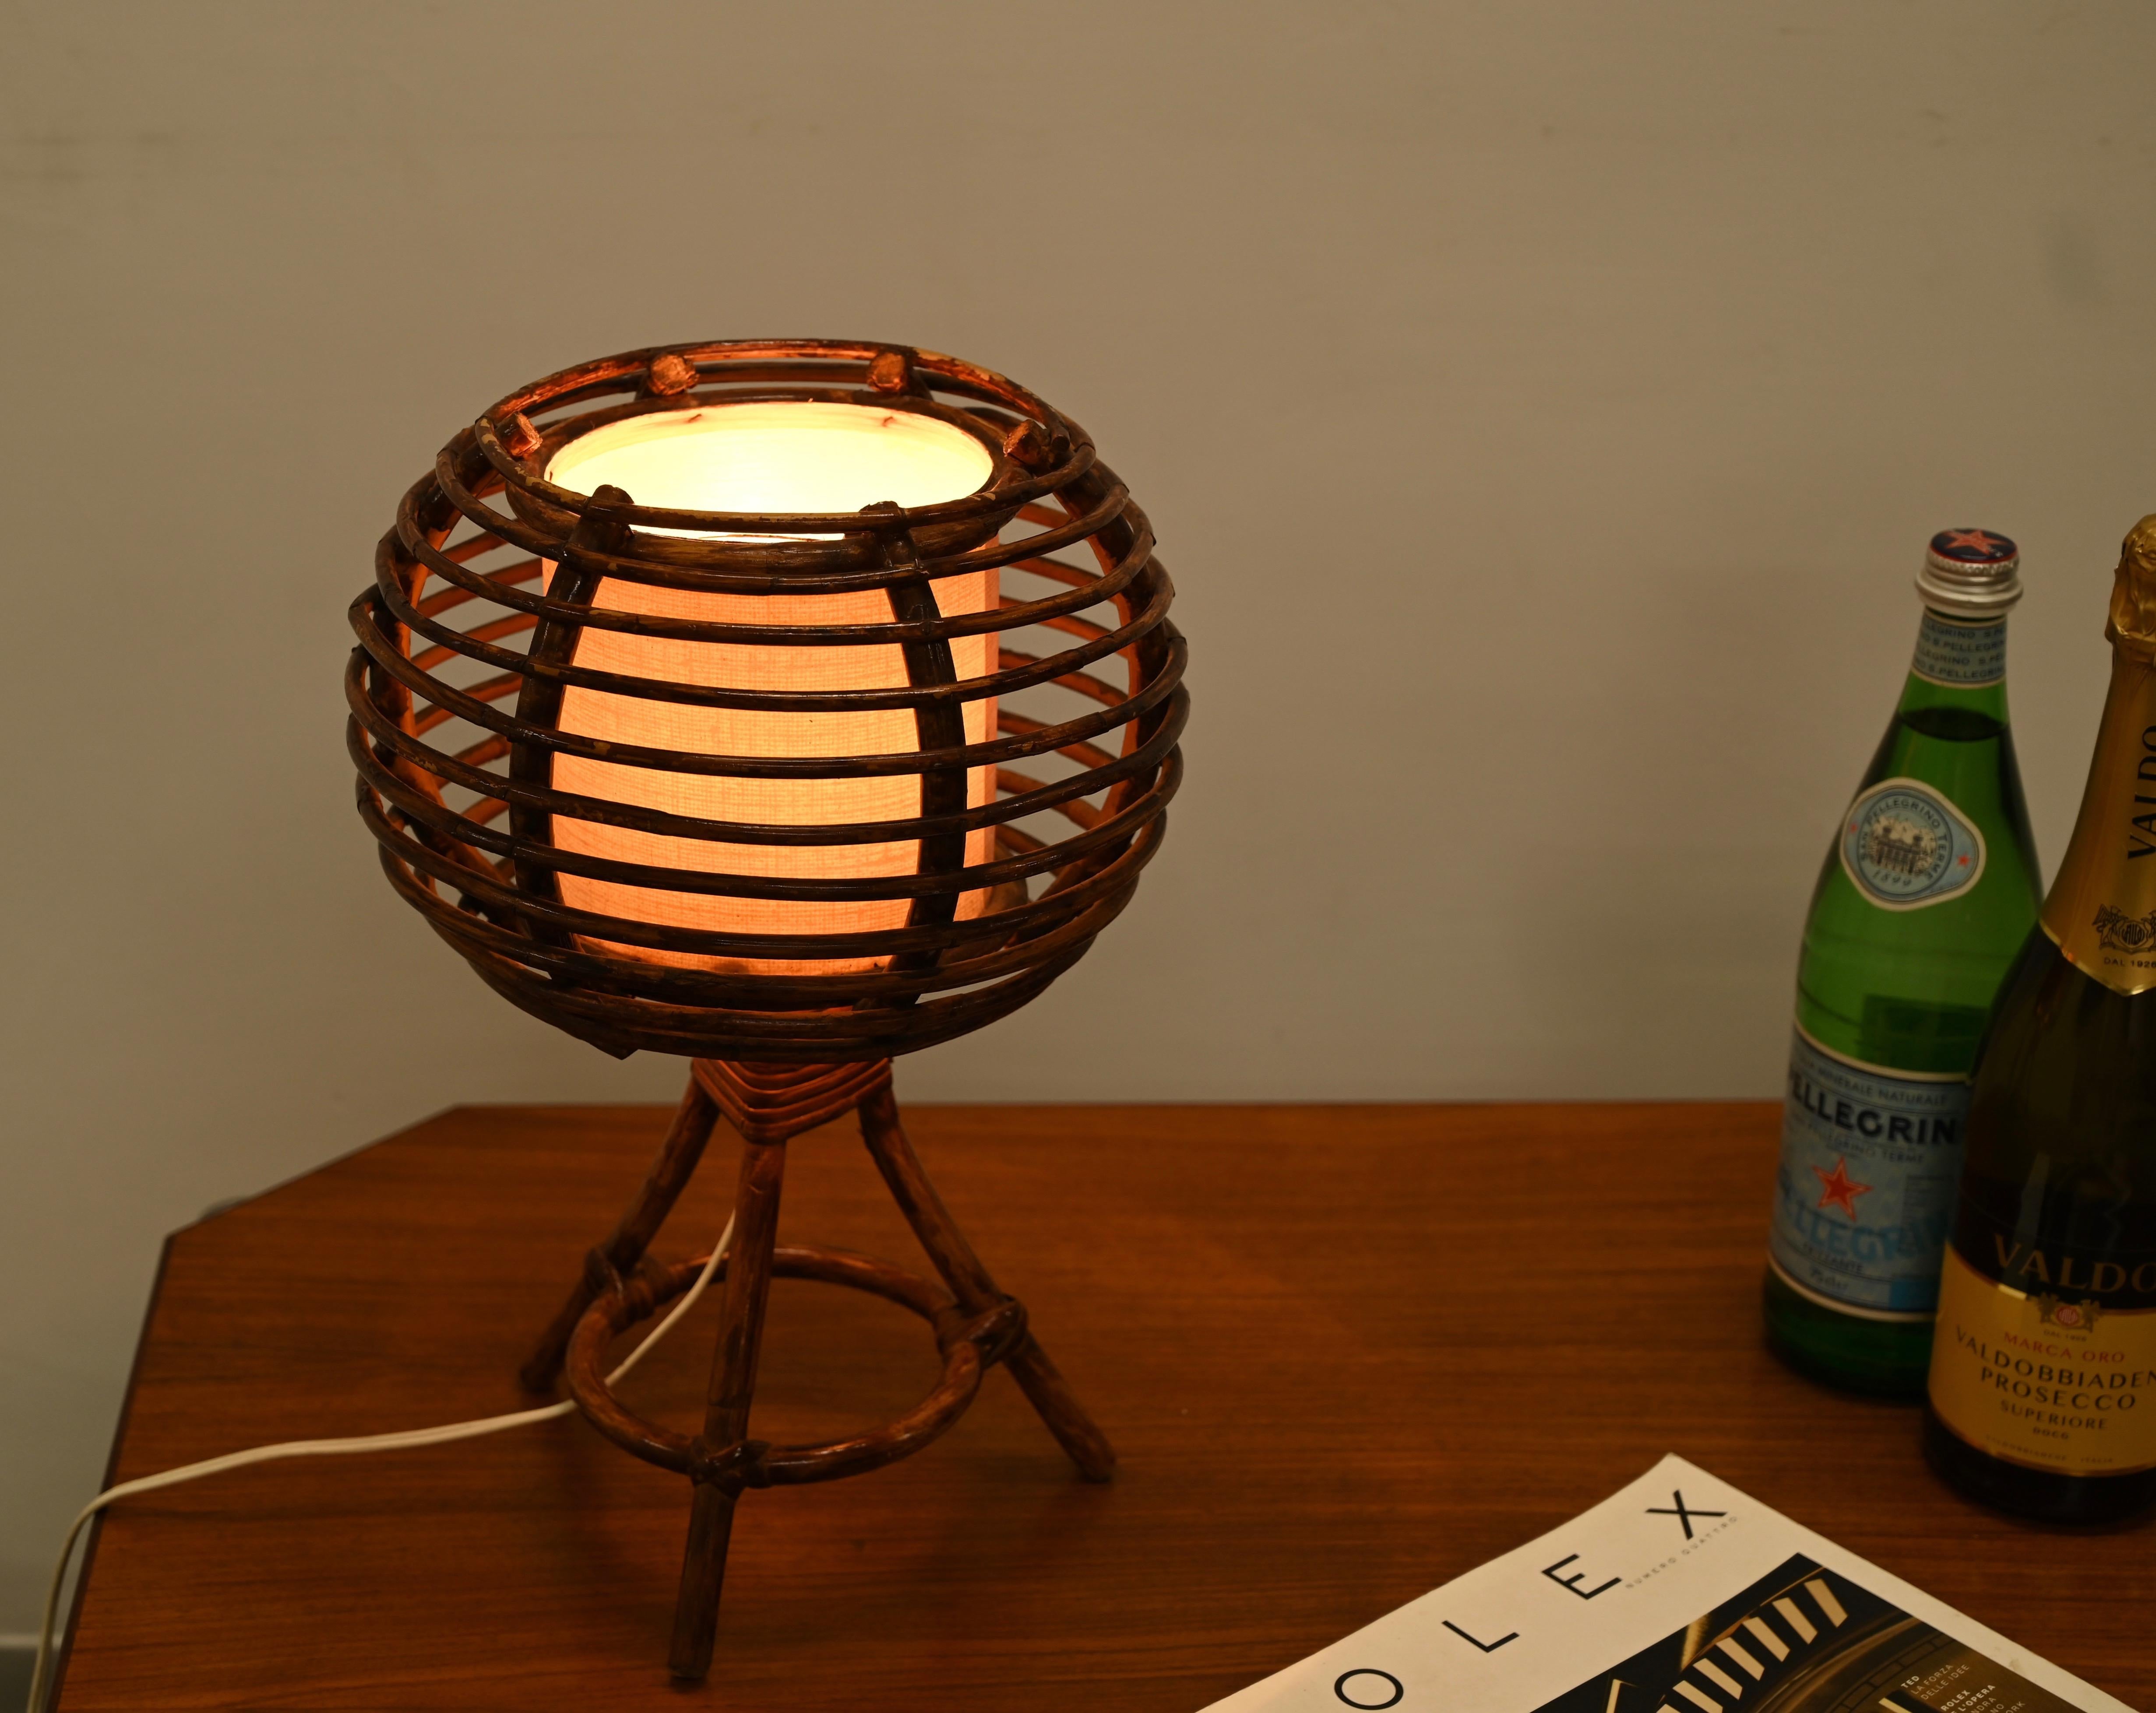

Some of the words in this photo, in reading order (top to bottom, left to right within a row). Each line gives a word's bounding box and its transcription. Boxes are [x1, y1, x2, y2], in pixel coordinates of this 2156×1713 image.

[1866, 797, 1941, 830] PELLEGRINO
[2103, 956, 2125, 966] DAL
[1994, 1233, 2156, 1293] VALDO
[2004, 1332, 2072, 1360] MARCA
[2082, 1351, 2126, 1363] ORO
[1981, 1366, 2136, 1411] PROSECCO
[2001, 1399, 2109, 1430] SUPERIORE
[1900, 1675, 1920, 1689] TED
[1911, 1685, 1924, 1695] LA
[1923, 1664, 1954, 1686] FORZA
[1920, 1680, 1949, 1700] DELLE
[1948, 1664, 1970, 1681] IDEE
[1940, 1689, 1971, 1711] ROLEX
[1958, 1684, 1996, 1712] L'OPERA
